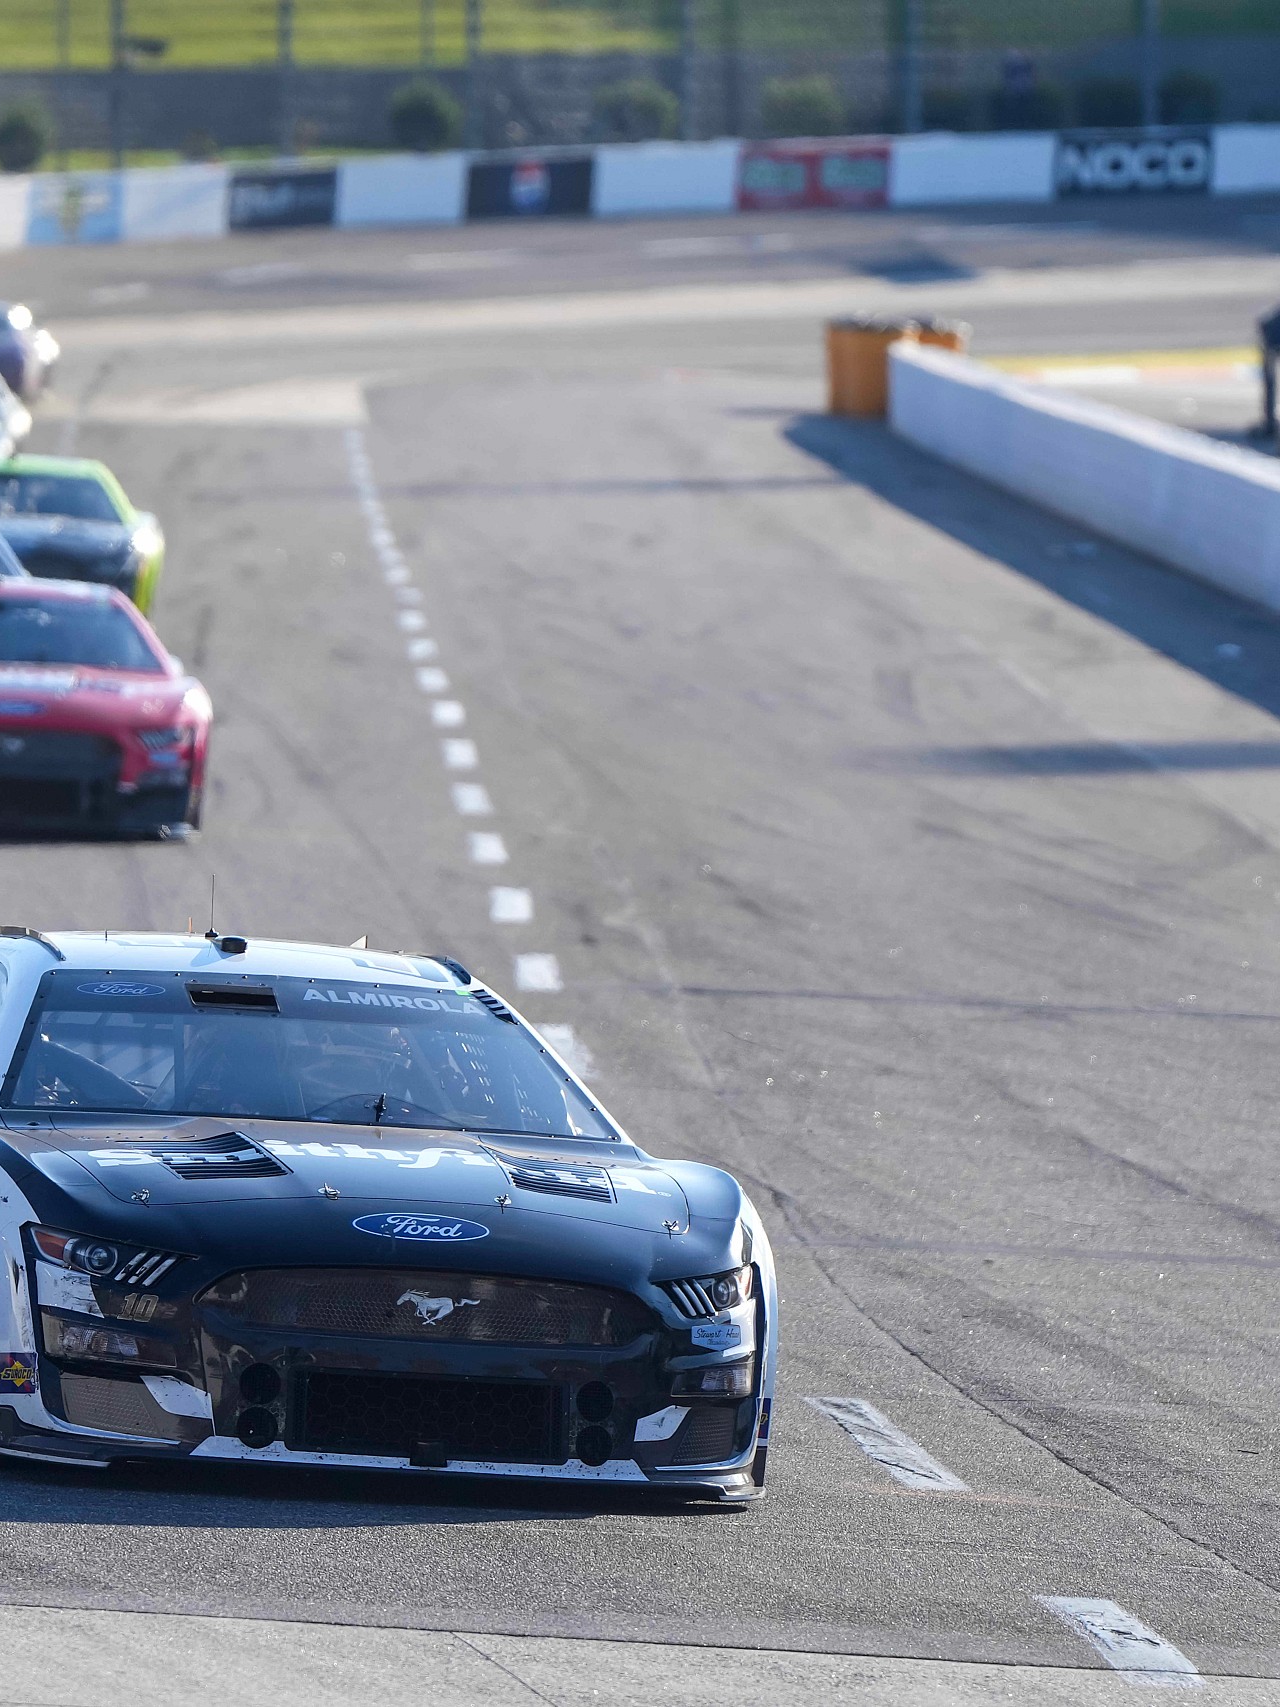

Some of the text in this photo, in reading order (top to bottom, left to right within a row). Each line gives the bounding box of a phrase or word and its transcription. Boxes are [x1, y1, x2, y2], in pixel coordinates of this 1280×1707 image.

[1058, 142, 1209, 189] NOCO
[303, 988, 487, 1016] ALMIROLA
[116, 1292, 160, 1323] 10
